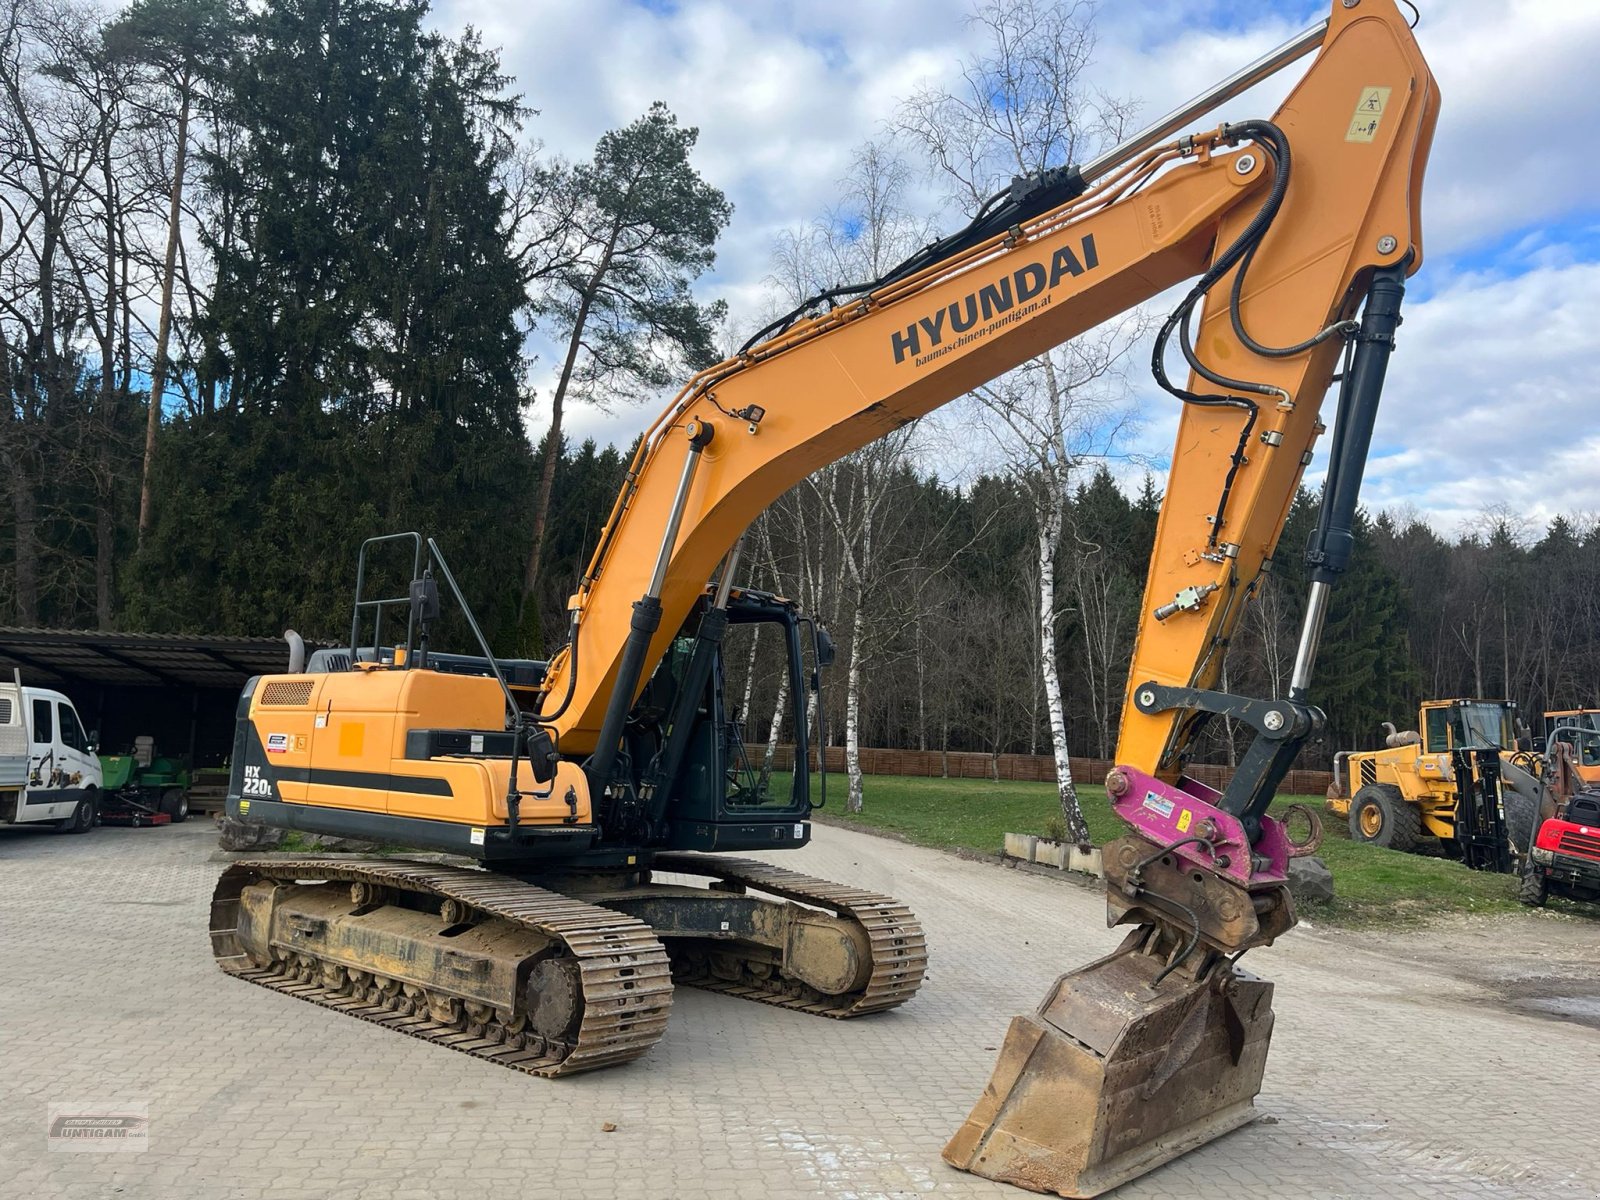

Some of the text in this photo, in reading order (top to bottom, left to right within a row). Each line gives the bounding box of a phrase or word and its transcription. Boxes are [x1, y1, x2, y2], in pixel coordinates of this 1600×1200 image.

[891, 233, 1099, 365] HYUNDAI
[915, 294, 1052, 368] baumaschinen-puntigam.at
[243, 778, 272, 796] 220L
[245, 765, 260, 778] HX
